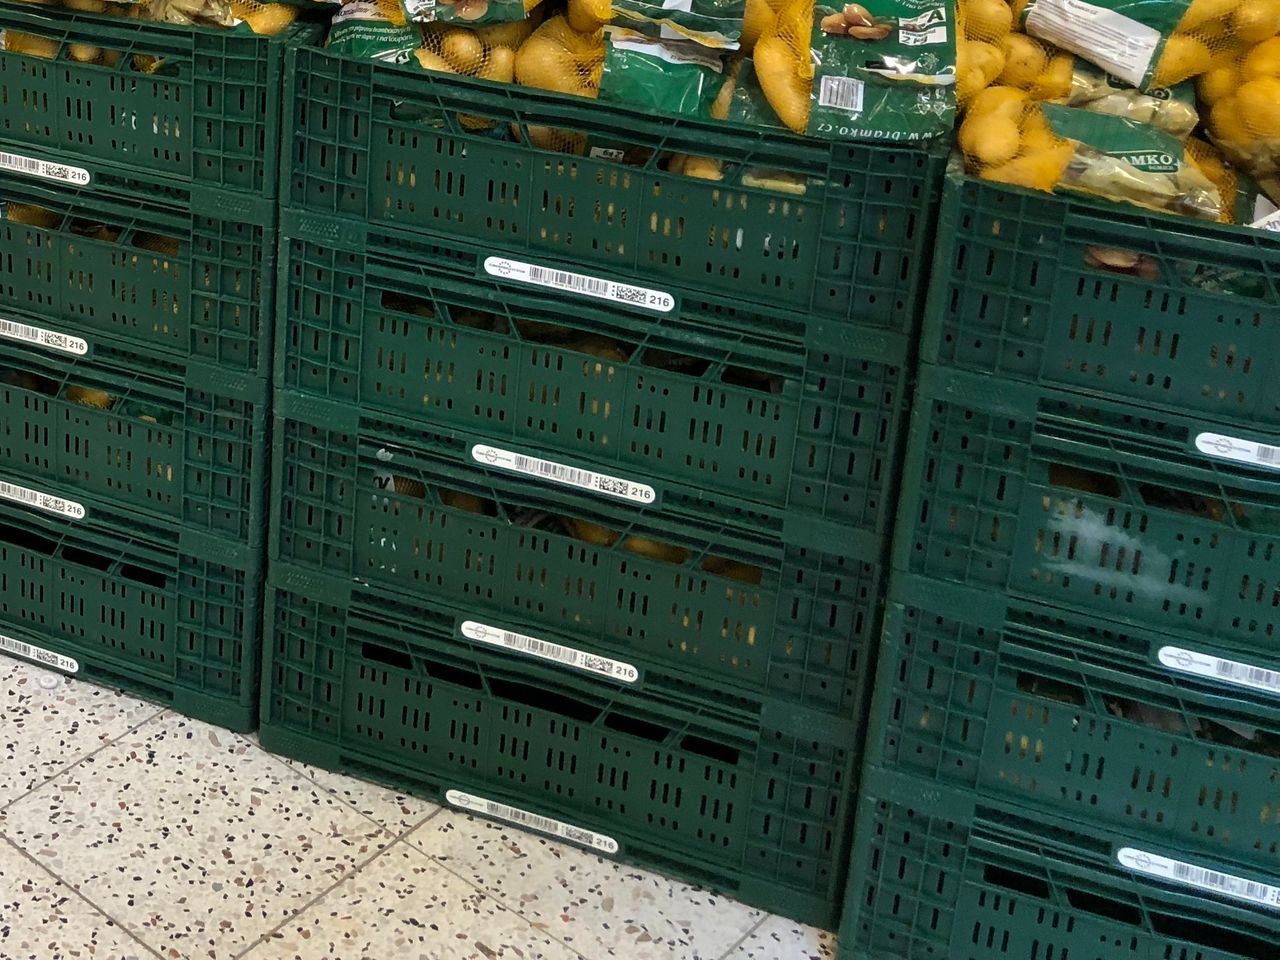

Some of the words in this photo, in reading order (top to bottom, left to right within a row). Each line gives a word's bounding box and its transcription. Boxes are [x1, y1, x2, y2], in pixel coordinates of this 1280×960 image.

[927, 10, 944, 23] A
[901, 36, 912, 44] 2
[1121, 154, 1173, 165] AMKO
[71, 171, 87, 181] 216
[649, 294, 670, 307] 216
[69, 340, 85, 351] 216
[631, 487, 651, 499] 216
[67, 503, 82, 516] 216
[60, 658, 75, 670] 216
[615, 665, 635, 678] 216
[596, 837, 615, 850] 216
